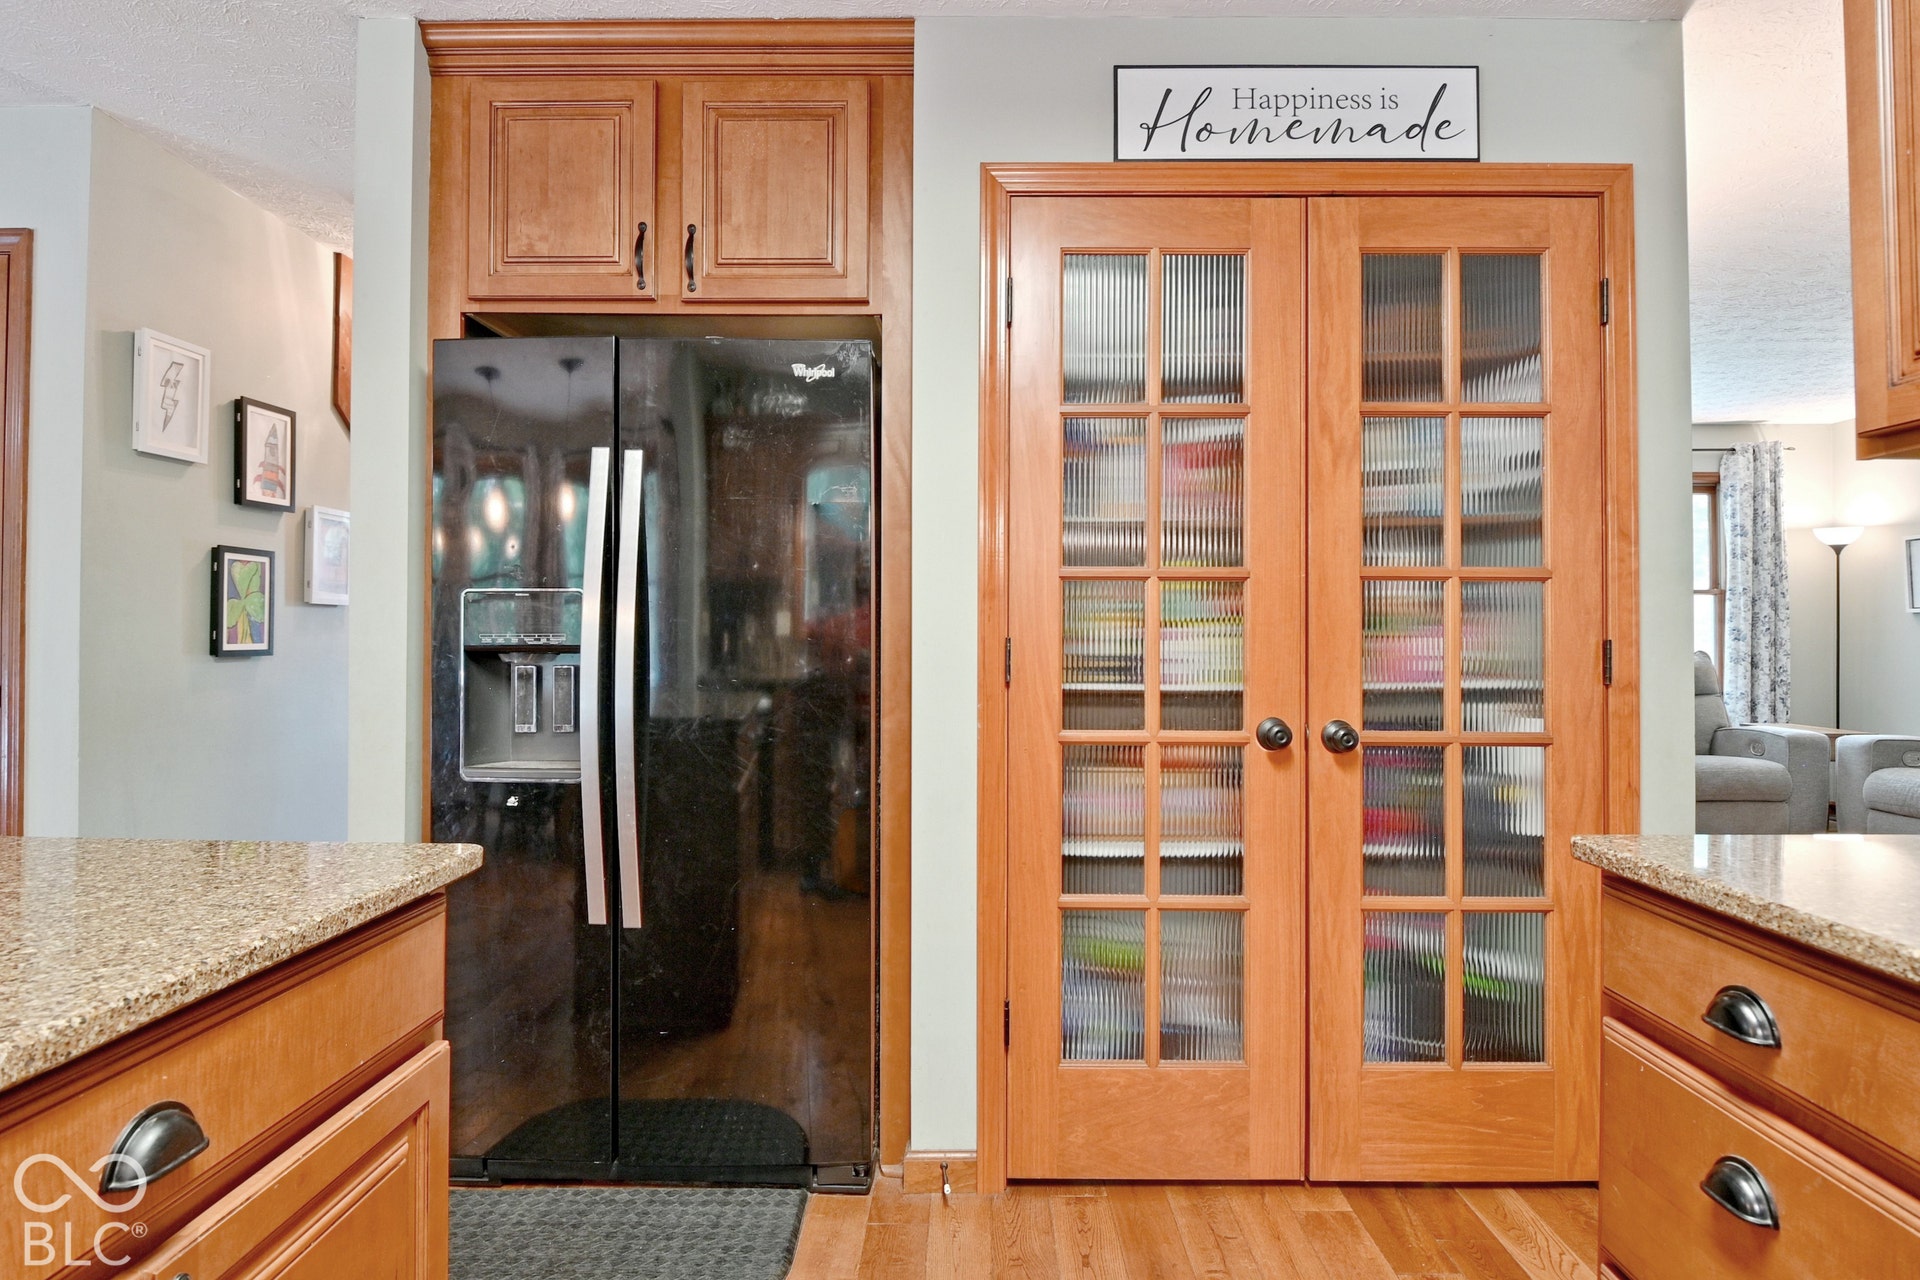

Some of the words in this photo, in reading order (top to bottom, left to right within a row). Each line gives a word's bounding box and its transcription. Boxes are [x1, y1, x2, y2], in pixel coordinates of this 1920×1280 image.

[1232, 87, 1372, 117] Happiness
[1380, 86, 1399, 110] is
[1140, 83, 1466, 152] Homemade
[791, 363, 835, 382] Whirlpool
